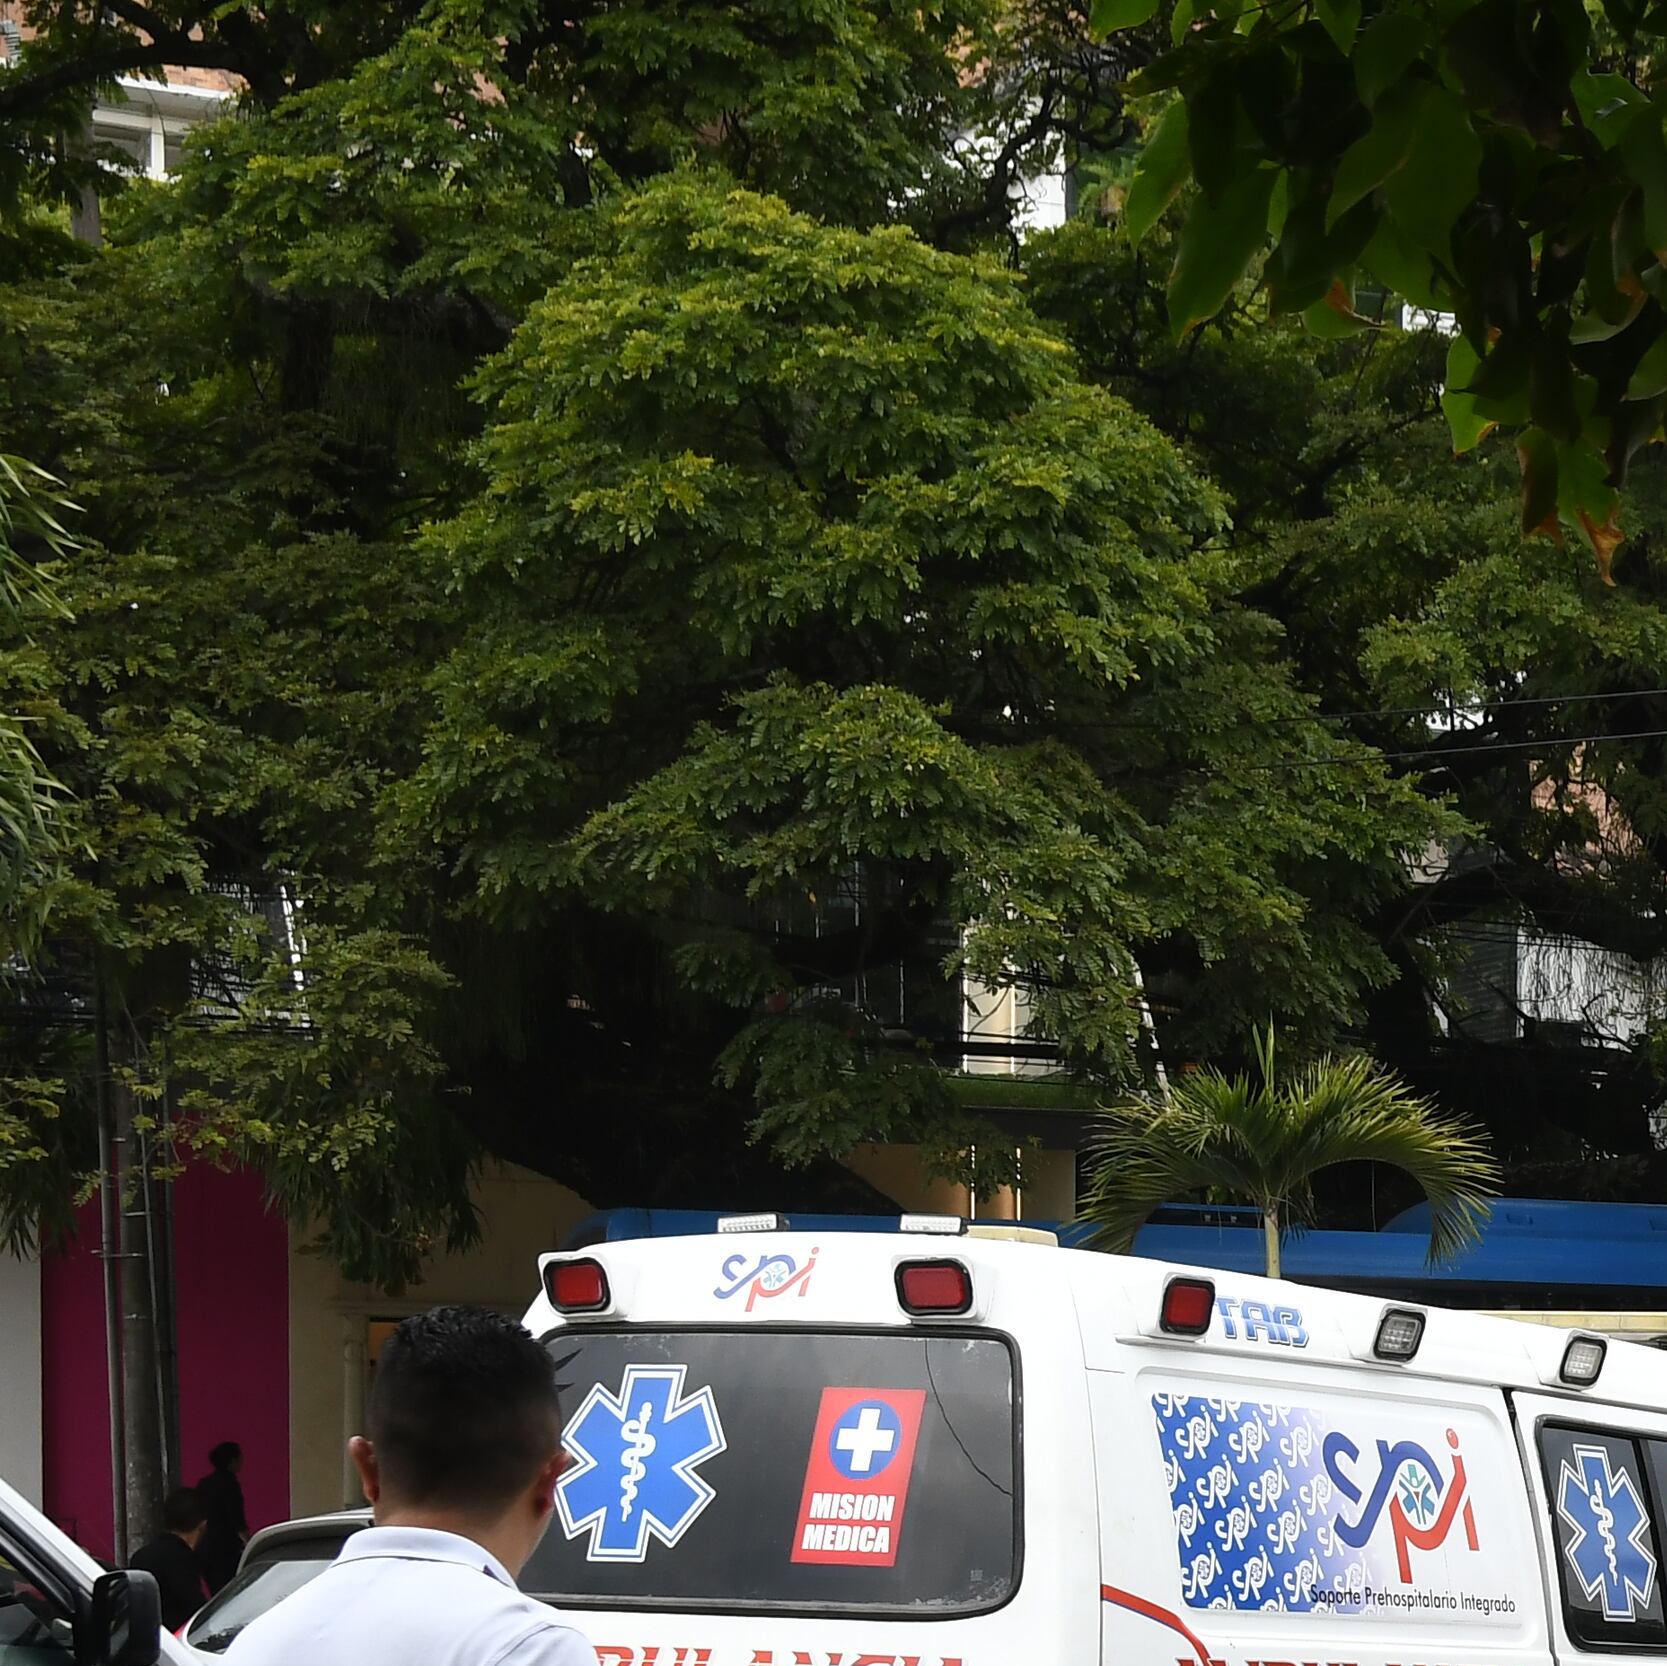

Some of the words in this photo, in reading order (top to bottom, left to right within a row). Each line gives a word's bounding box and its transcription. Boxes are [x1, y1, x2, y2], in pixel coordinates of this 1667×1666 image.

[1215, 1295, 1309, 1347] TAB
[809, 1493, 895, 1521] MISION
[801, 1524, 891, 1553] MEDICA
[1311, 1584, 1361, 1609] Soporte
[1365, 1586, 1457, 1612] Prehospitalario
[1461, 1590, 1516, 1616] Integrado
